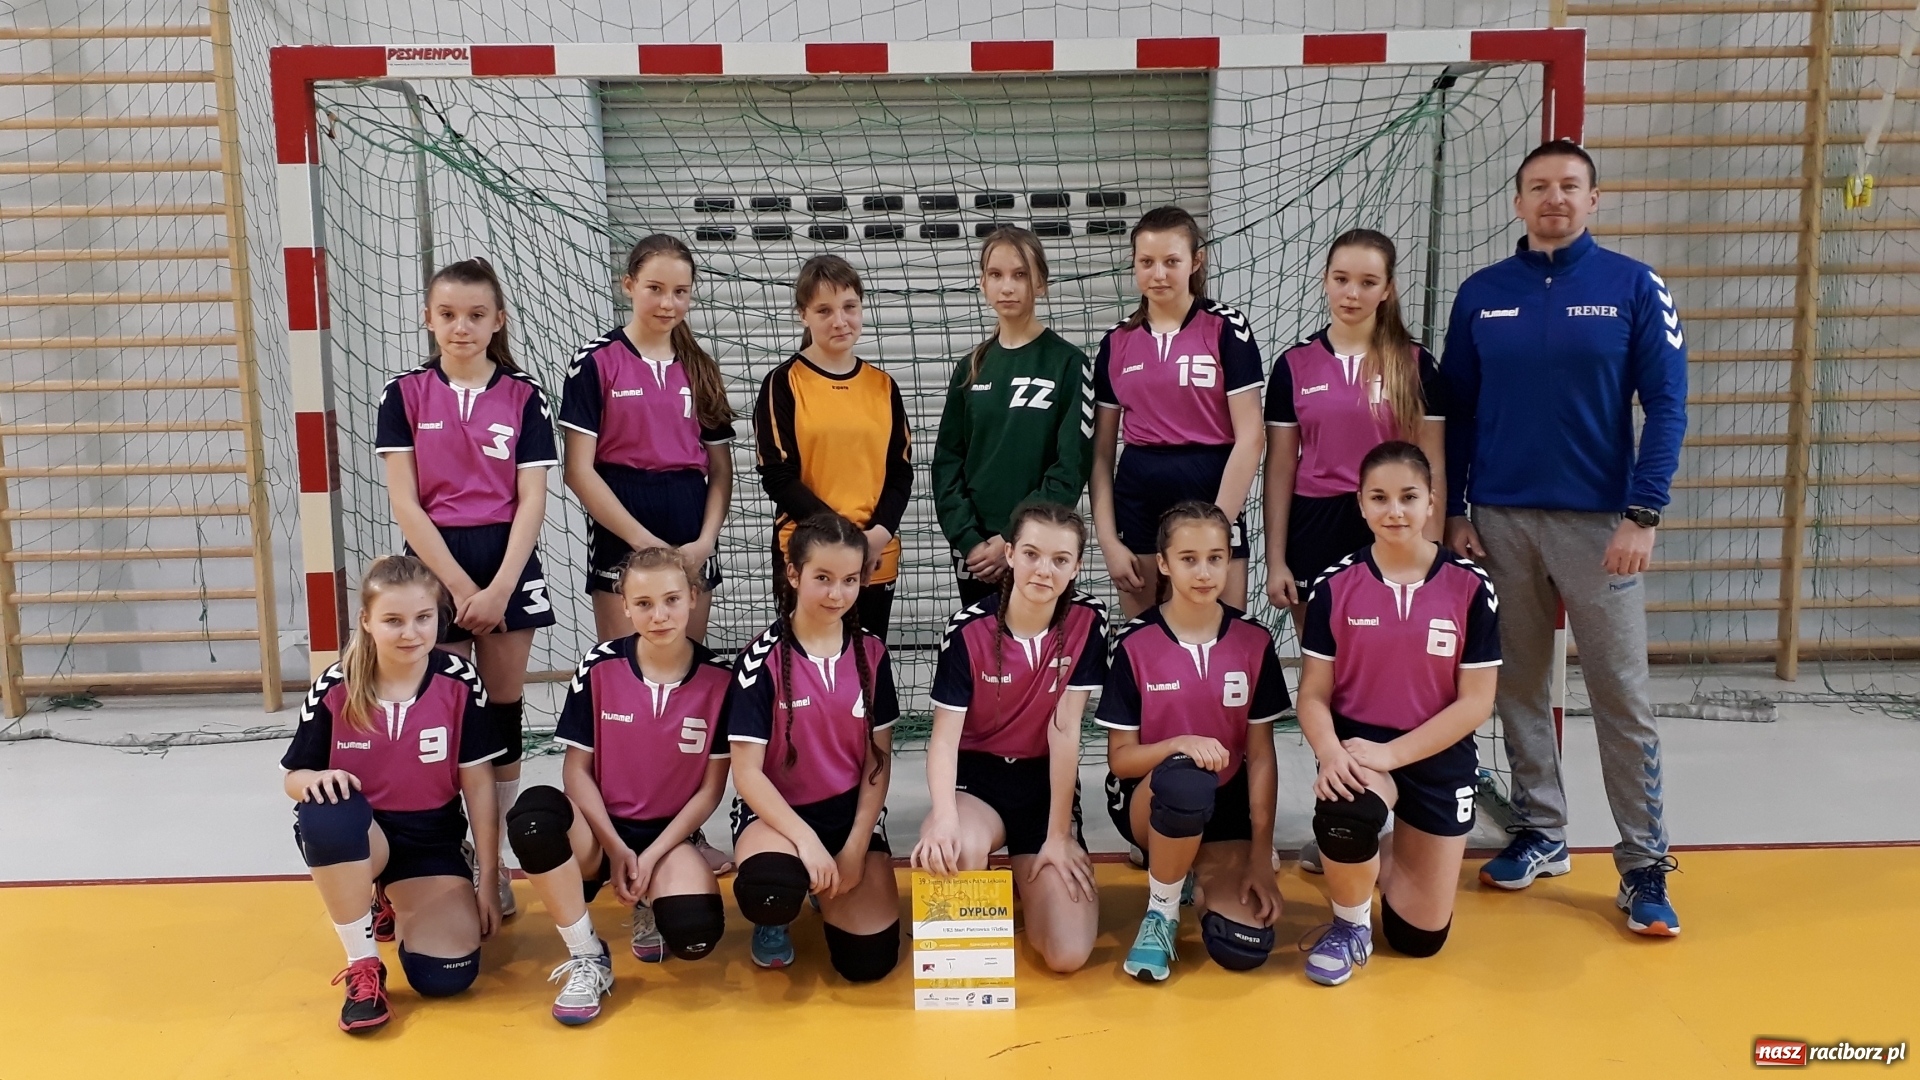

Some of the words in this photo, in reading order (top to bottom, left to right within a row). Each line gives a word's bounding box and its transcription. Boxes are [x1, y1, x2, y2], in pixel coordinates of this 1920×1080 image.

[387, 48, 469, 60] PESMENPOL
[1480, 307, 1519, 319] hummel
[1566, 305, 1618, 317] TRENER
[1122, 362, 1144, 375] ummel
[1175, 354, 1218, 388] 15
[611, 387, 643, 398] hummel
[971, 382, 992, 391] mmel
[1301, 383, 1328, 396] hummel
[1009, 377, 1056, 410] 22
[418, 420, 443, 430] ummel
[482, 423, 515, 460] 3
[522, 579, 551, 615] 3
[1347, 616, 1380, 628] hummel
[1426, 619, 1458, 657] 6
[1048, 656, 1072, 693] 7
[1146, 680, 1181, 692] hummel
[1223, 671, 1248, 707] 8
[601, 710, 634, 723] hummel
[677, 717, 708, 754] 5
[337, 740, 371, 750] hummel
[418, 726, 448, 764] 9
[1456, 786, 1477, 823] 6
[960, 907, 1008, 917] DYPLOM
